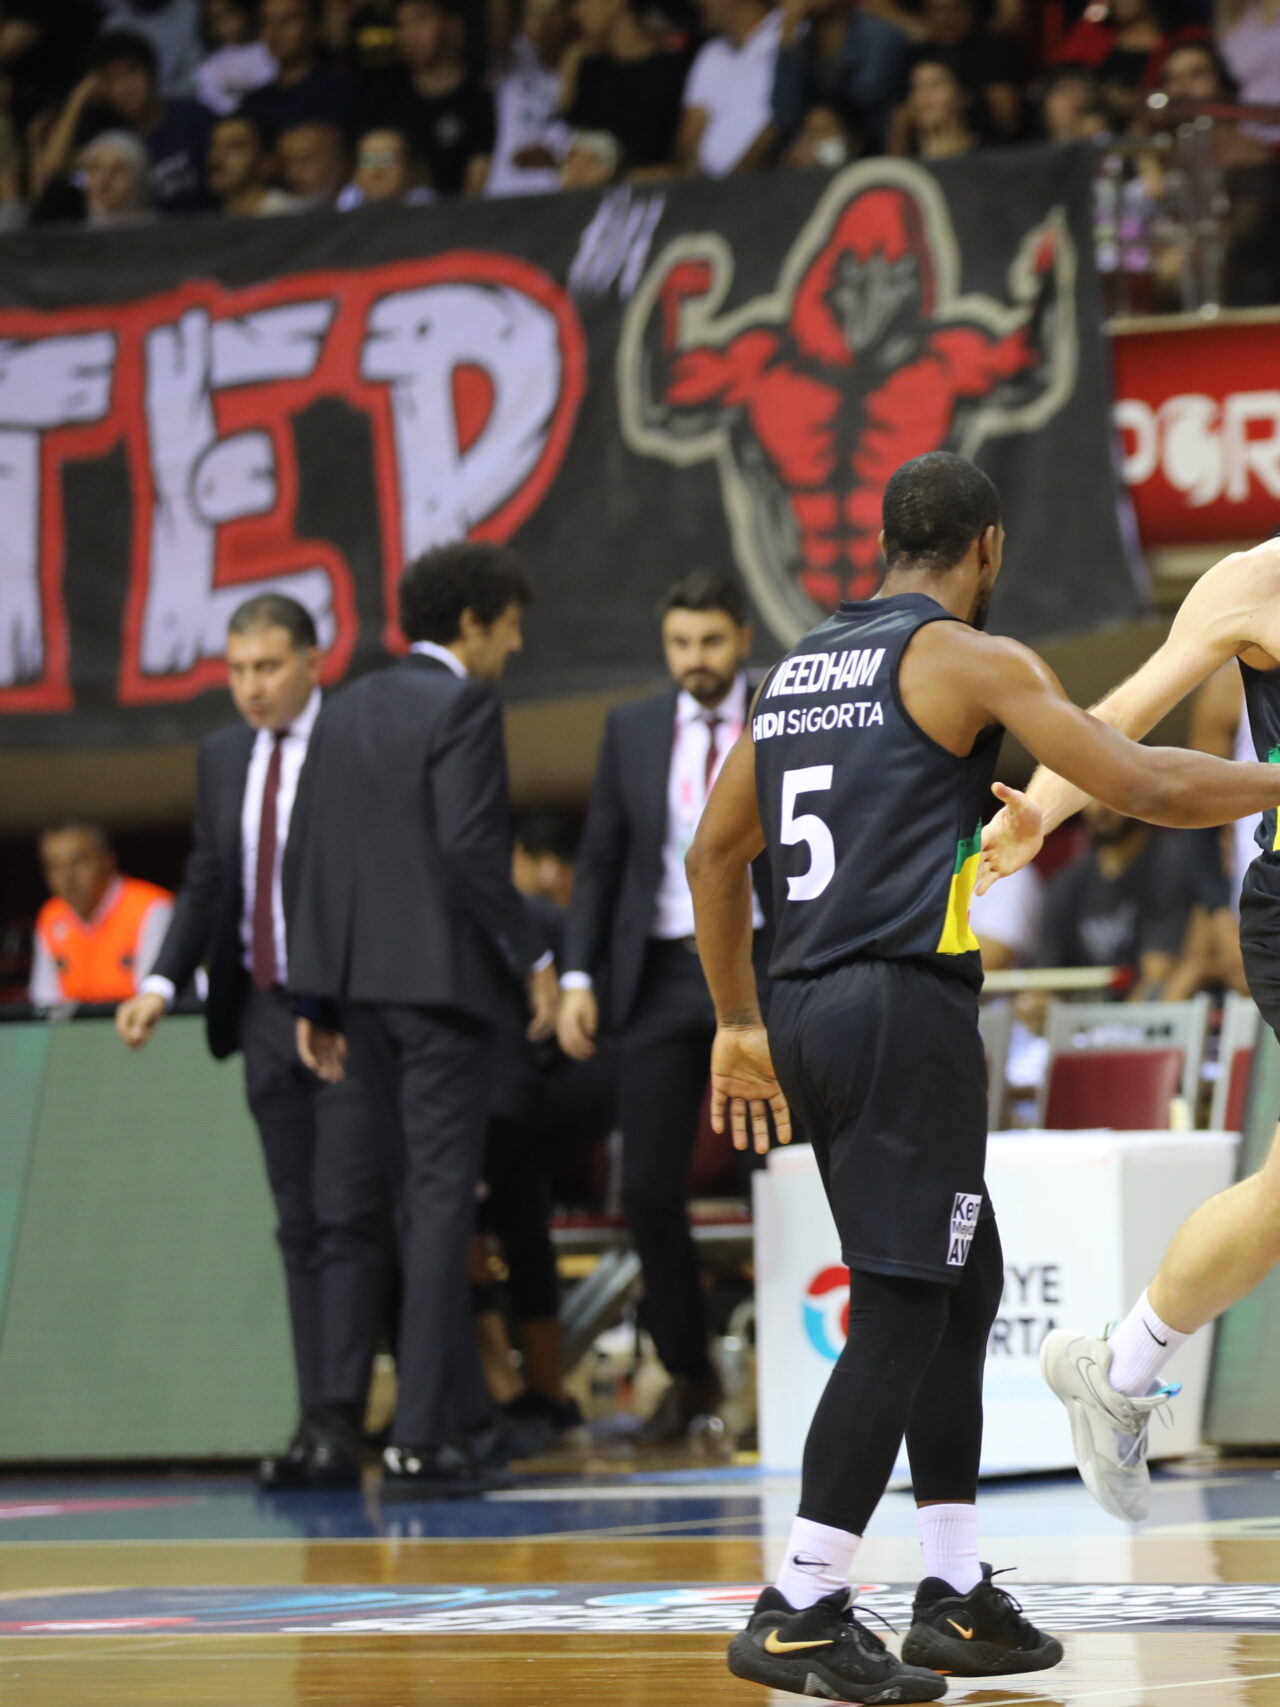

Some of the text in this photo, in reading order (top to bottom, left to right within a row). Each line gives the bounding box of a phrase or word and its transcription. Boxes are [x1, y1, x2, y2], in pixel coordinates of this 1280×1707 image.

[766, 648, 886, 698] NEEDHAM
[753, 711, 785, 742] HDI
[780, 764, 836, 901] 5
